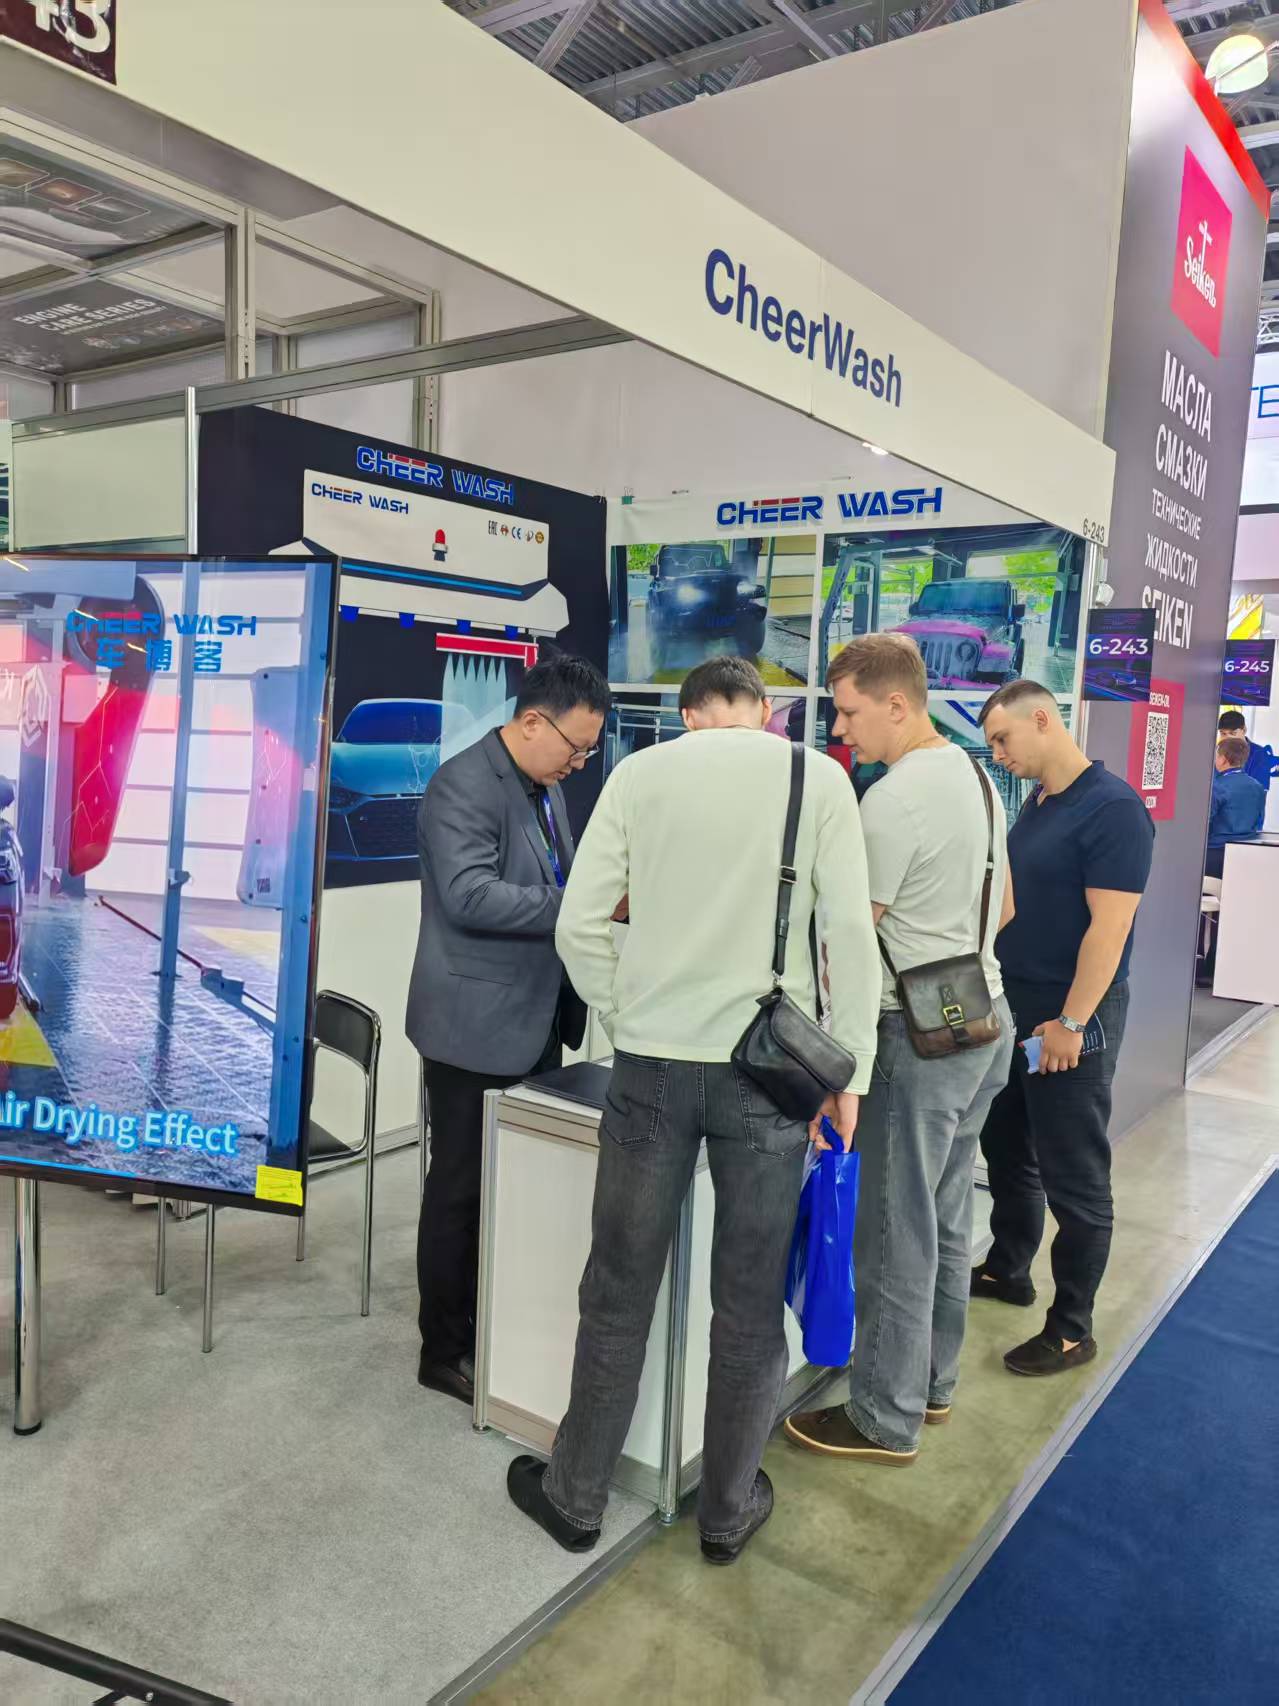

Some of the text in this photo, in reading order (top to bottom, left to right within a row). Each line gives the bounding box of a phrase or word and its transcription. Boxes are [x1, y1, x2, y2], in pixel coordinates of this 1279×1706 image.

[13, 302, 88, 325] ENGINE
[39, 314, 94, 332] CARE
[84, 298, 157, 321] SERIES
[705, 248, 902, 408] CheerWash
[1161, 350, 1213, 442] МАСЛА
[356, 445, 514, 506] CHEER WASH
[1155, 424, 1208, 501] СМАЗКИ
[311, 483, 410, 515] CHEER WASH
[716, 487, 943, 526] CHEER WASH
[1152, 488, 1202, 540] ТЕХНИЧЕСКИЕ
[1082, 518, 1106, 543] 6-243
[1145, 533, 1199, 589] ЖИДКОСТИ
[66, 610, 258, 636] CHEER WASH
[1089, 638, 1149, 655] 6-243
[1224, 660, 1270, 673] 6-245
[34, 1096, 135, 1149] Drying
[144, 1112, 237, 1154] Effect
